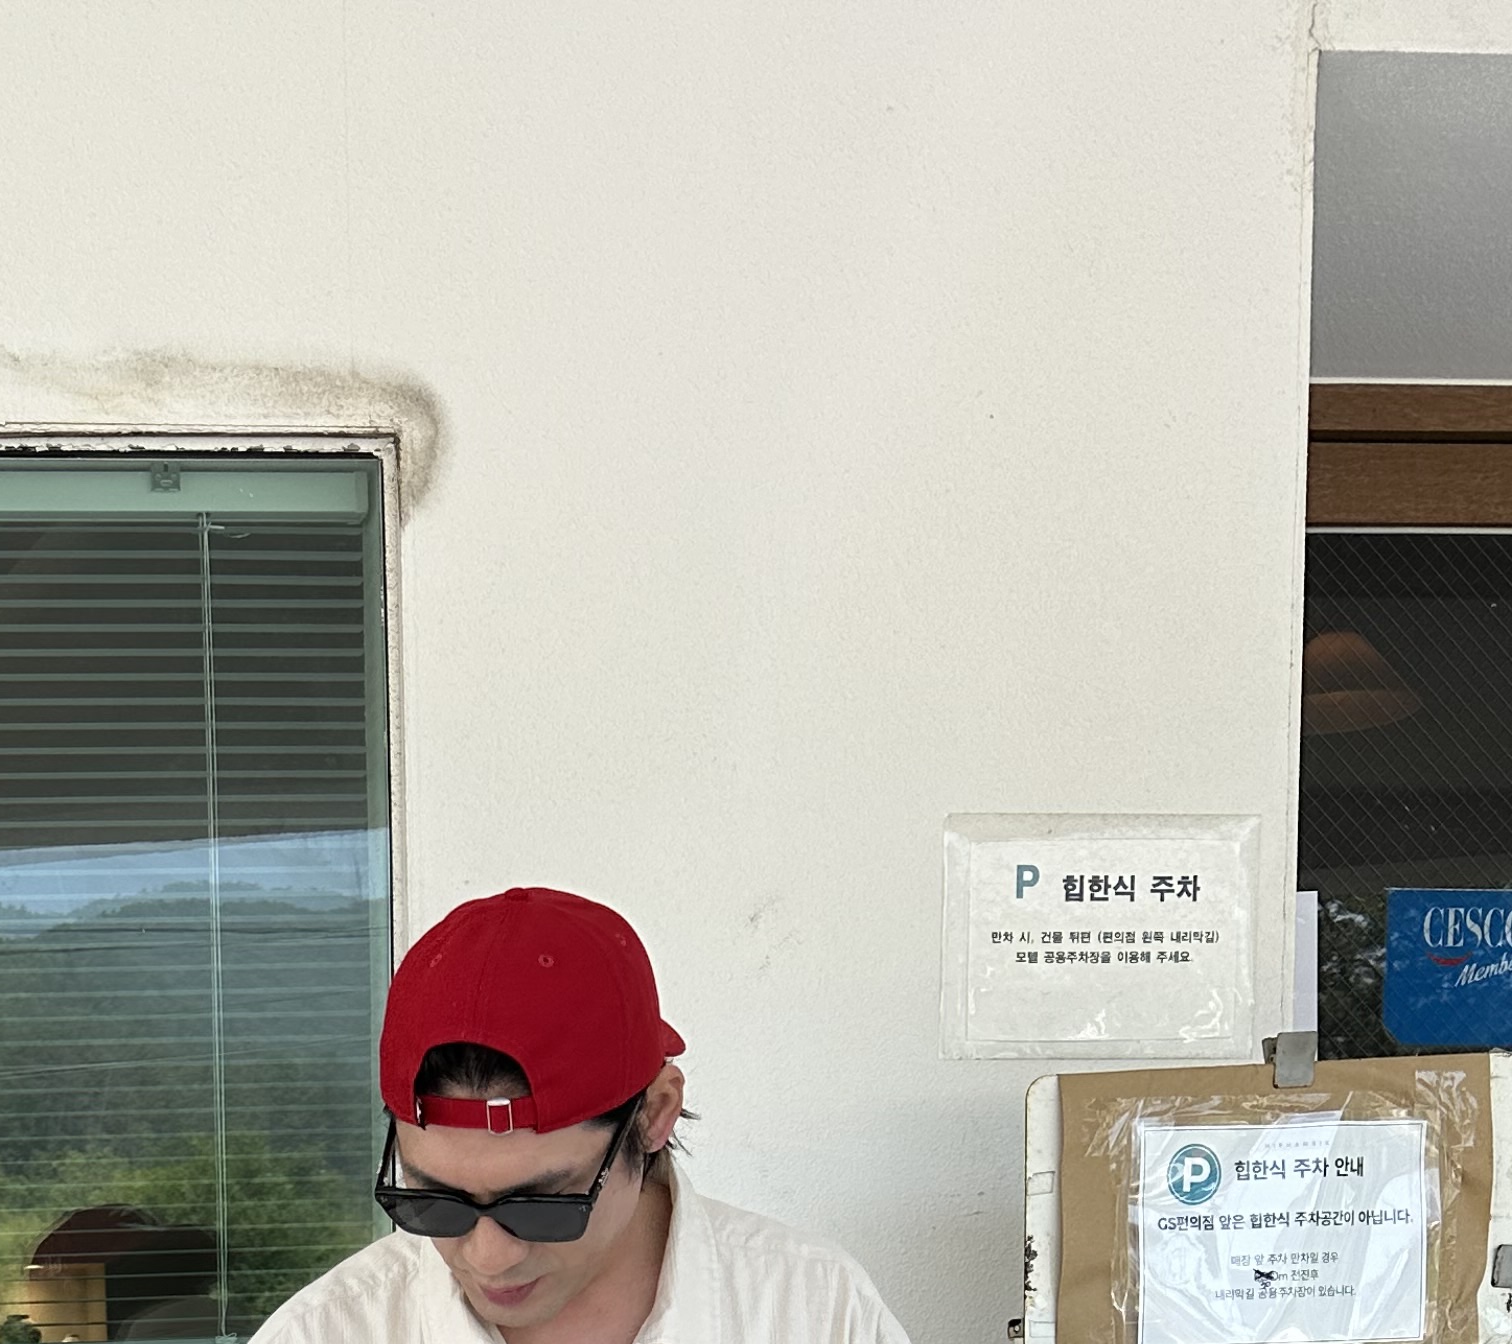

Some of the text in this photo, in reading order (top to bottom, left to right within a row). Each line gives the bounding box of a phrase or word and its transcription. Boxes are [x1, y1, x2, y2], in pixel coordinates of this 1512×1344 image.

[1016, 864, 1040, 899] P
[1062, 874, 1201, 902] 힙한식 주차
[991, 931, 1014, 944] 만차
[1041, 931, 1064, 944] 건물
[1170, 930, 1220, 944] 내리막길)
[1044, 951, 1112, 964] 공용주차장을
[1117, 951, 1151, 964] 이용해
[1182, 1157, 1211, 1193] P
[1234, 1156, 1364, 1181] 힙한식 주차 안내
[1157, 1208, 1414, 1232] GS편의점 앞은 힙한식 주차공간이 아닙니다.
[1230, 1254, 1251, 1267] 매장
[1268, 1253, 1287, 1265] 주차
[1291, 1252, 1319, 1265] 만차일
[1318, 1285, 1356, 1297] 있습니다.
